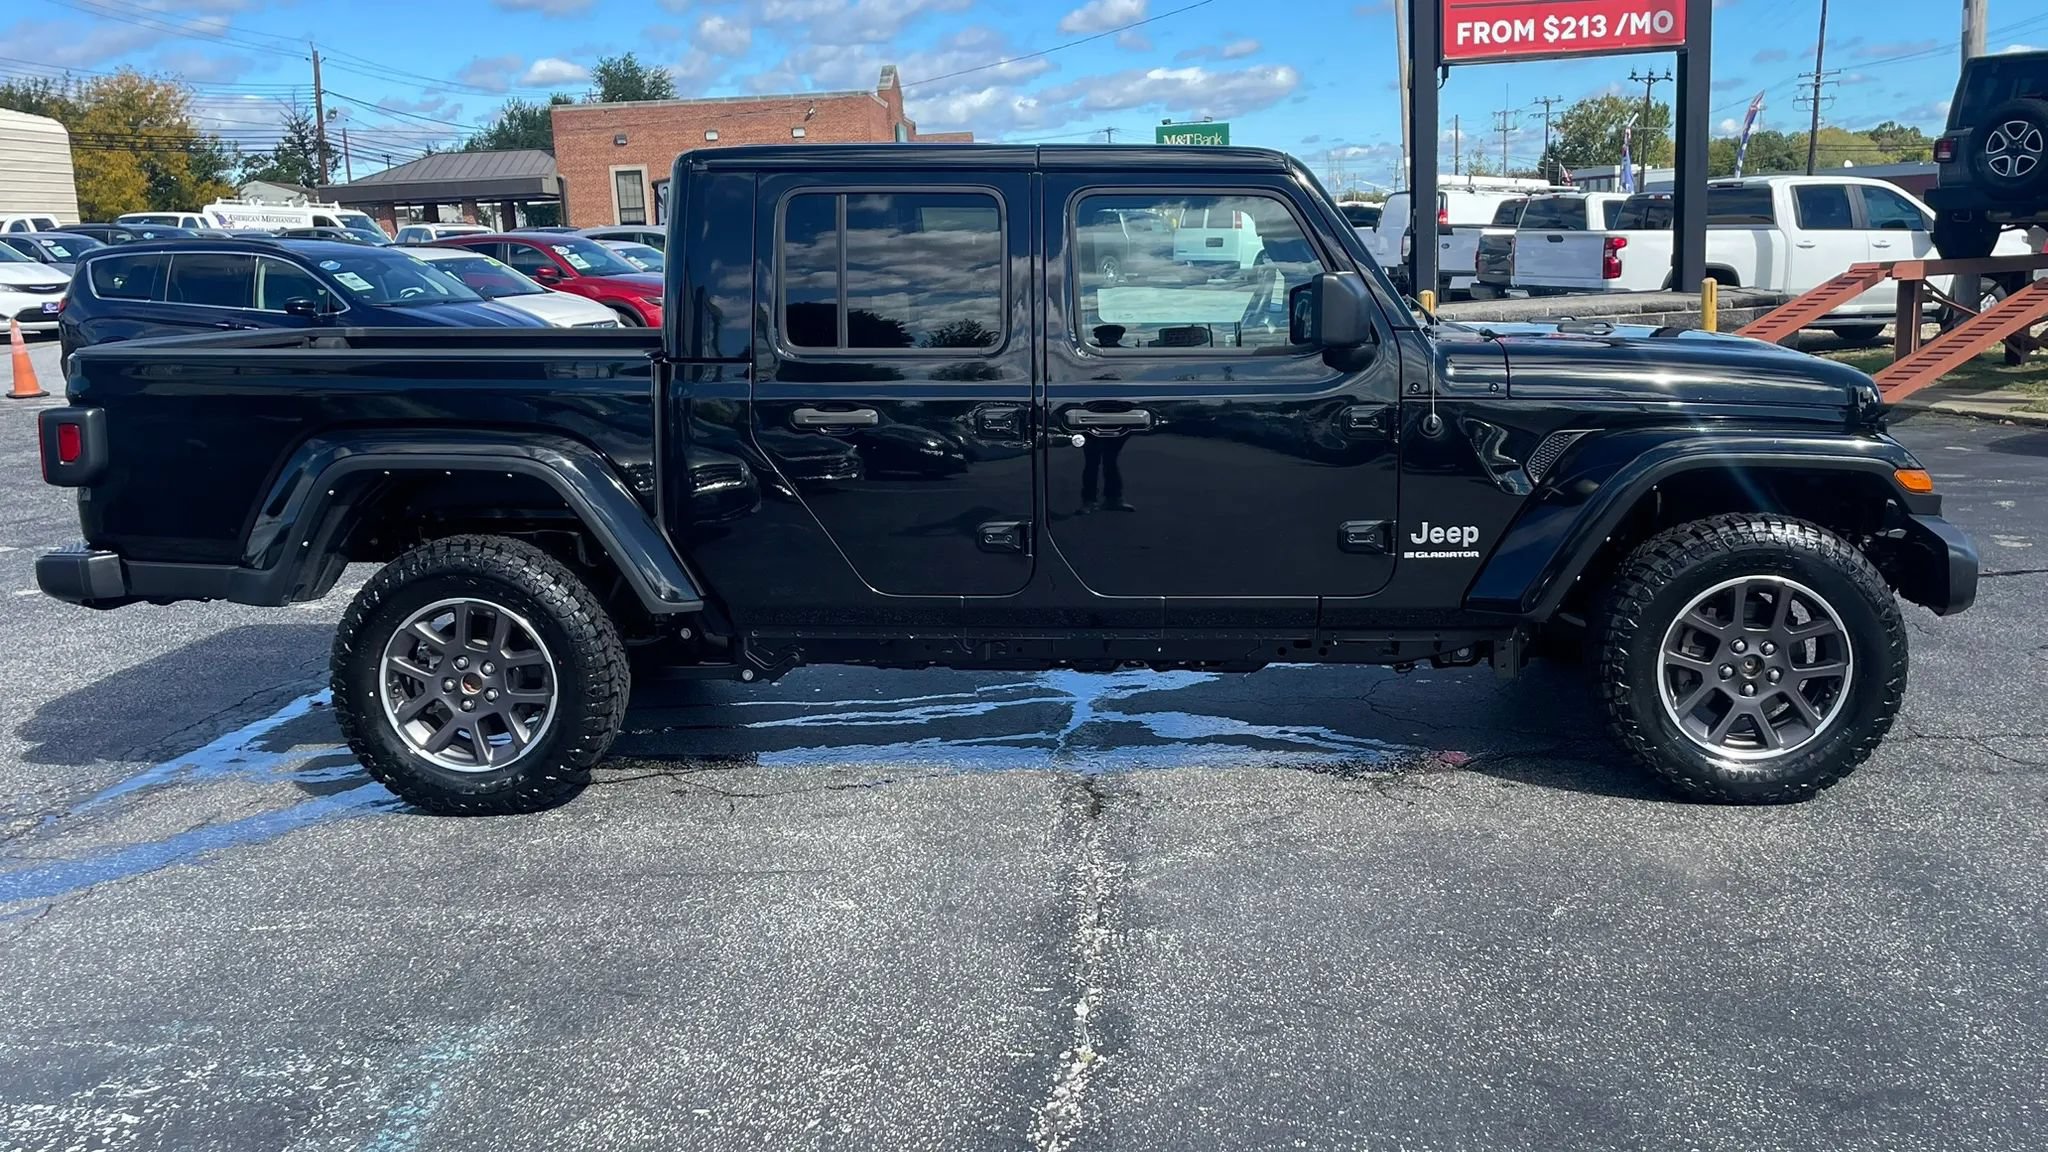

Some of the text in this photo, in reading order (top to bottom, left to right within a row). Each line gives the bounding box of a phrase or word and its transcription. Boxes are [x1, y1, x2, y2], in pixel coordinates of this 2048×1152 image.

[1457, 10, 1674, 45] FROM $213 /MO
[228, 214, 302, 224] AMERICAN MECHANICAL
[1410, 521, 1479, 547] Jeep
